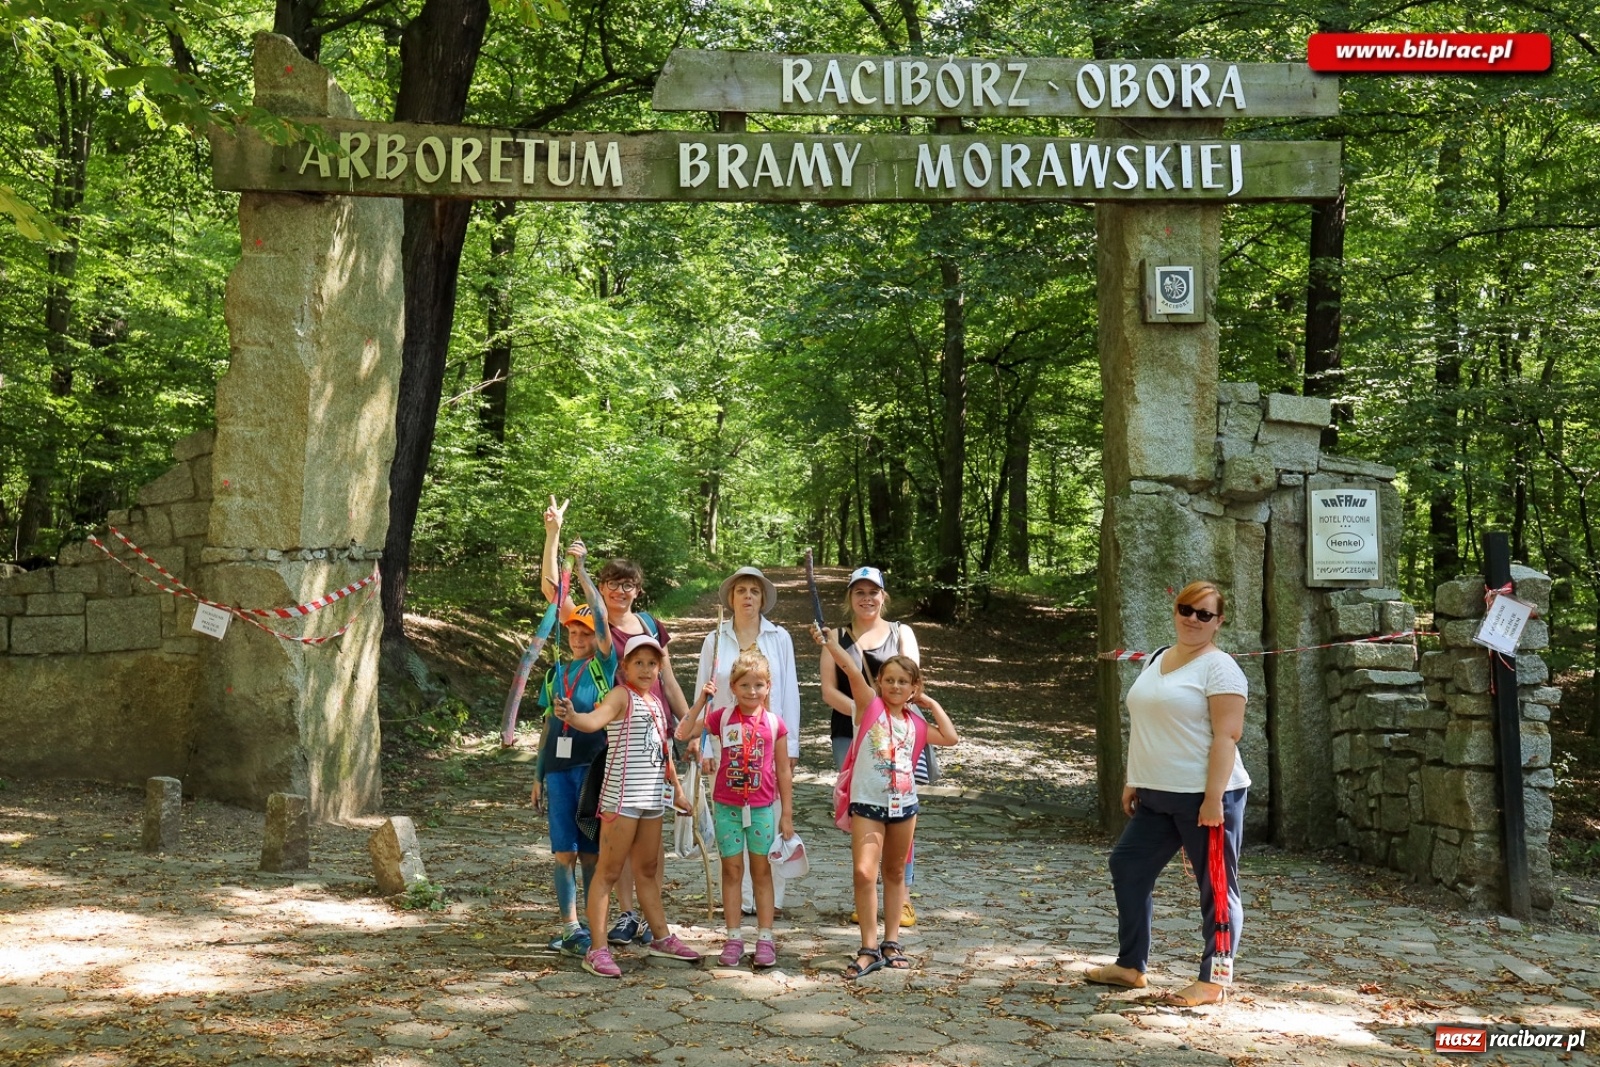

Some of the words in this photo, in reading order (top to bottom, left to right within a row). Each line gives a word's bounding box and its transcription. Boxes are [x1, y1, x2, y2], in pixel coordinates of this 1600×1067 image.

[782, 56, 1030, 108] RACIBÓRZ
[1075, 62, 1247, 109] OBORA
[298, 132, 623, 187] ARBORETUM
[678, 142, 861, 189] BRAMY
[915, 143, 1243, 196] MORAWSKIEJ
[1321, 494, 1367, 507] RAFAKO
[1343, 515, 1370, 523] POLONIA
[1330, 539, 1361, 547] Henkel
